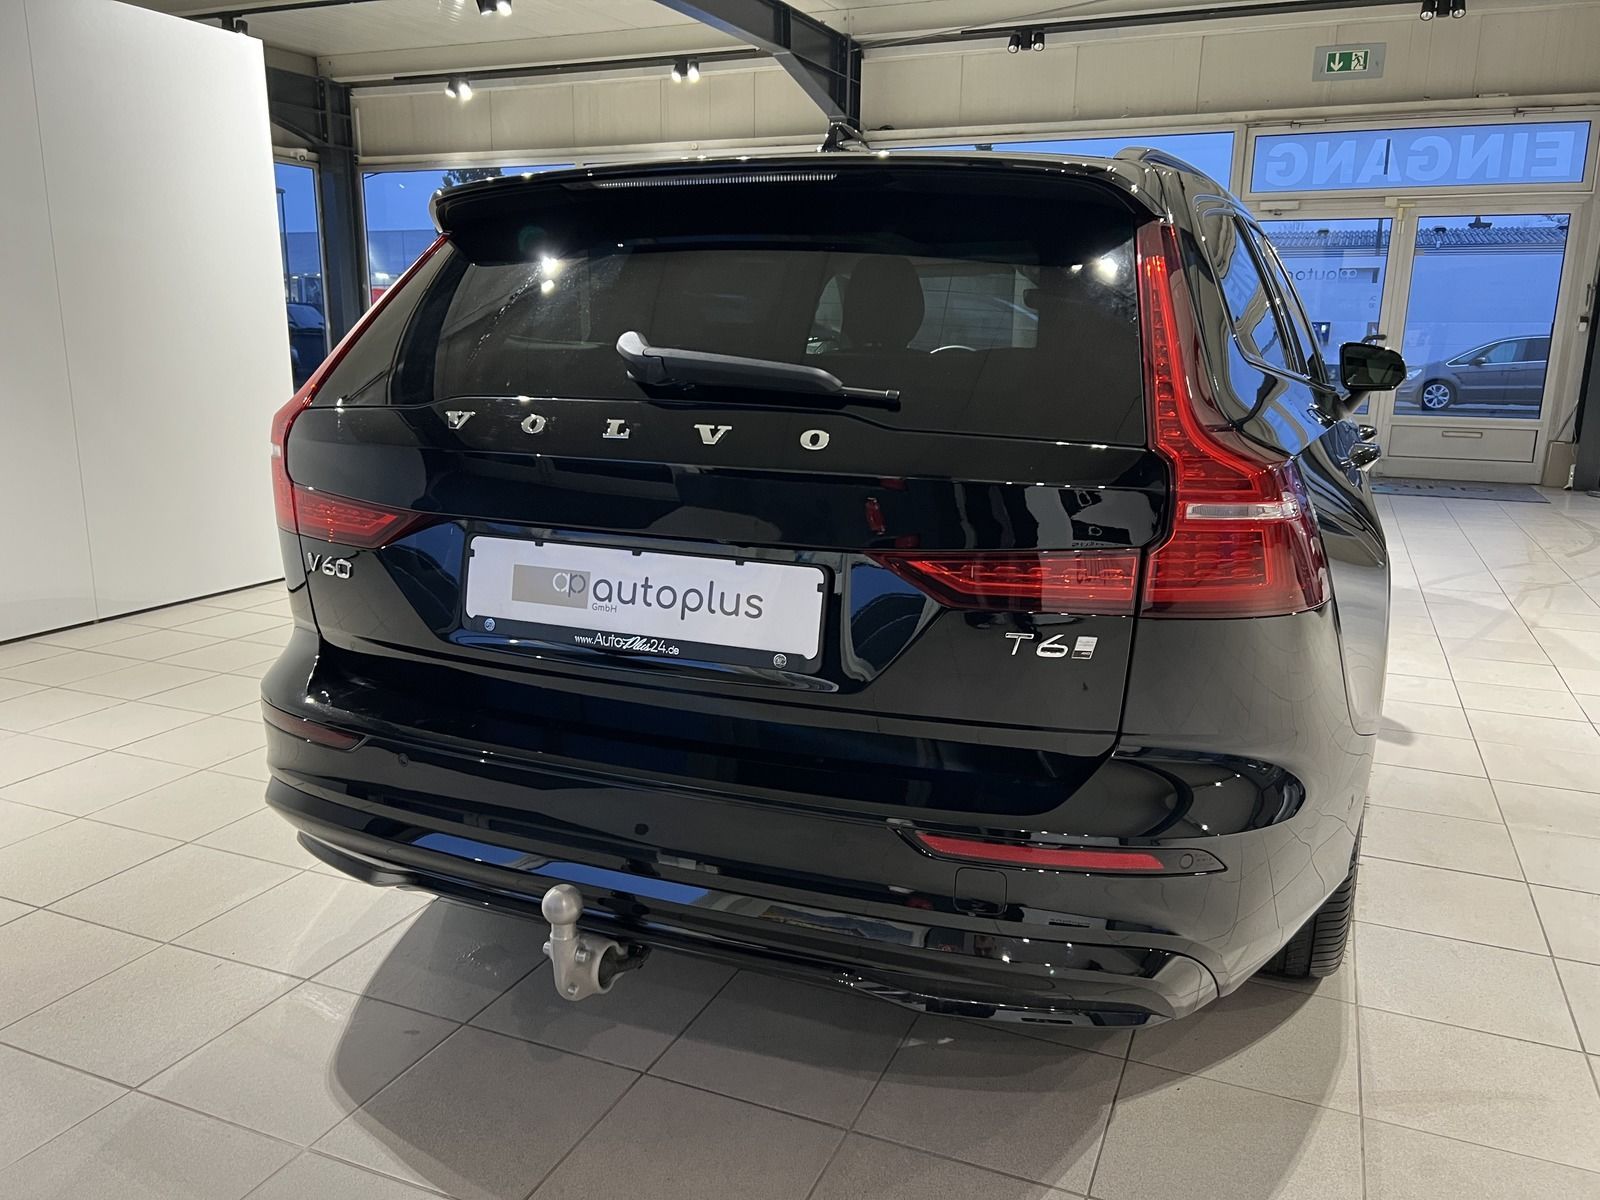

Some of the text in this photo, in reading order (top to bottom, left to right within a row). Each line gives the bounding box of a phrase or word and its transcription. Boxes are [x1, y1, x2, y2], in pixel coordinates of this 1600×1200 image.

[445, 410, 830, 451] VOLVO
[307, 552, 352, 579] V60
[592, 577, 764, 620] autoplus
[592, 602, 618, 613] GmbH
[1005, 632, 1069, 658] T6
